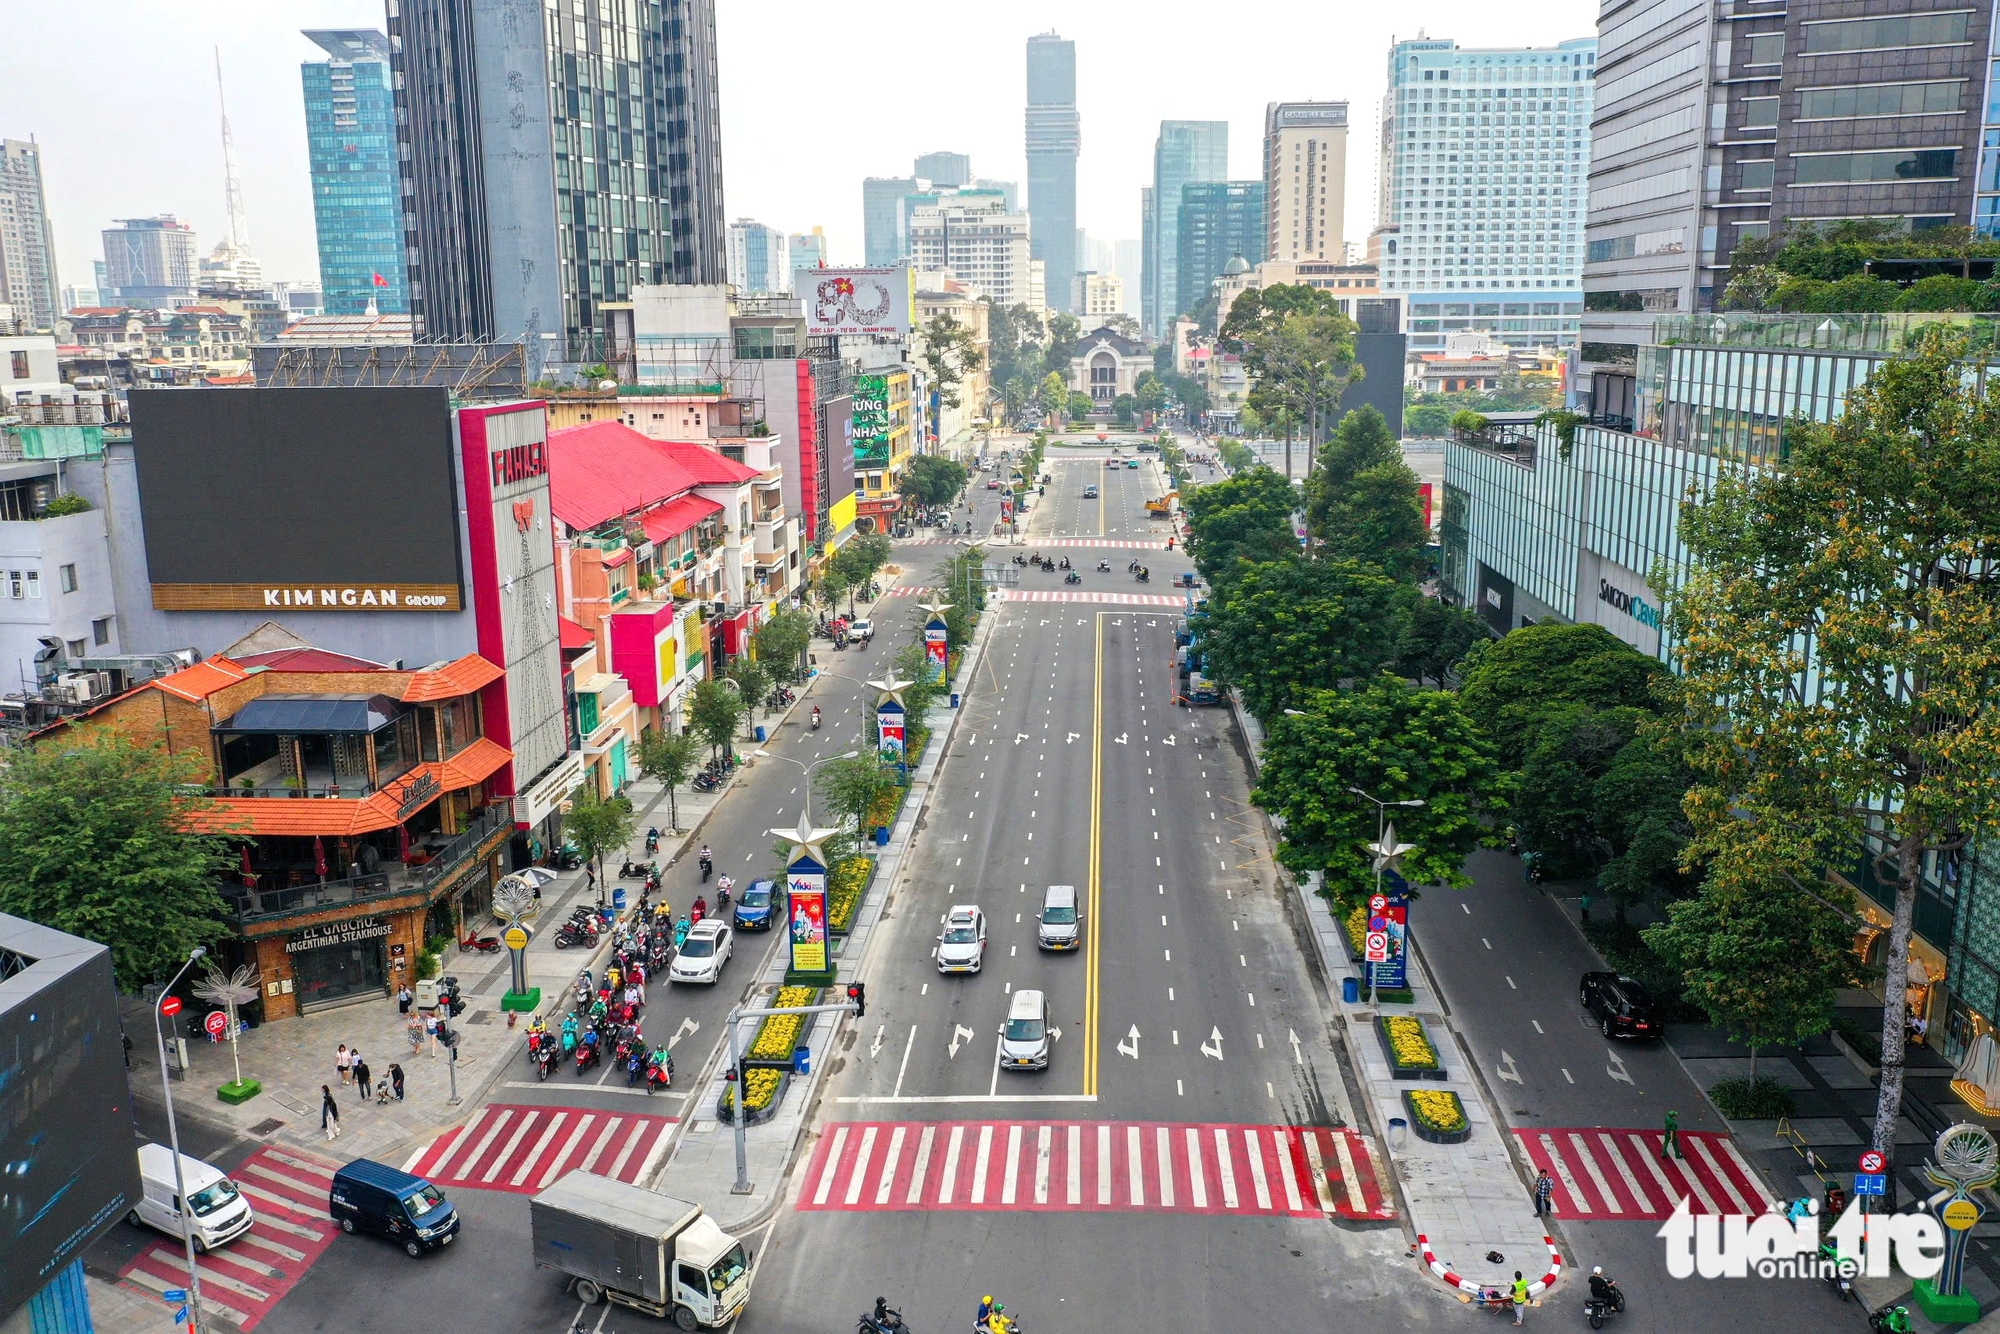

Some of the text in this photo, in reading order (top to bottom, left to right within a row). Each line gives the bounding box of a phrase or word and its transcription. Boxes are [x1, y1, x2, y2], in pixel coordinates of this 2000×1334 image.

[853, 425, 878, 438] NHÀ
[491, 442, 548, 487] FAHASA
[263, 589, 447, 606] KIM NGAN GROUP
[789, 878, 812, 891] Vikki
[285, 924, 393, 954] ARGENTINIAN STEAKHOUSE
